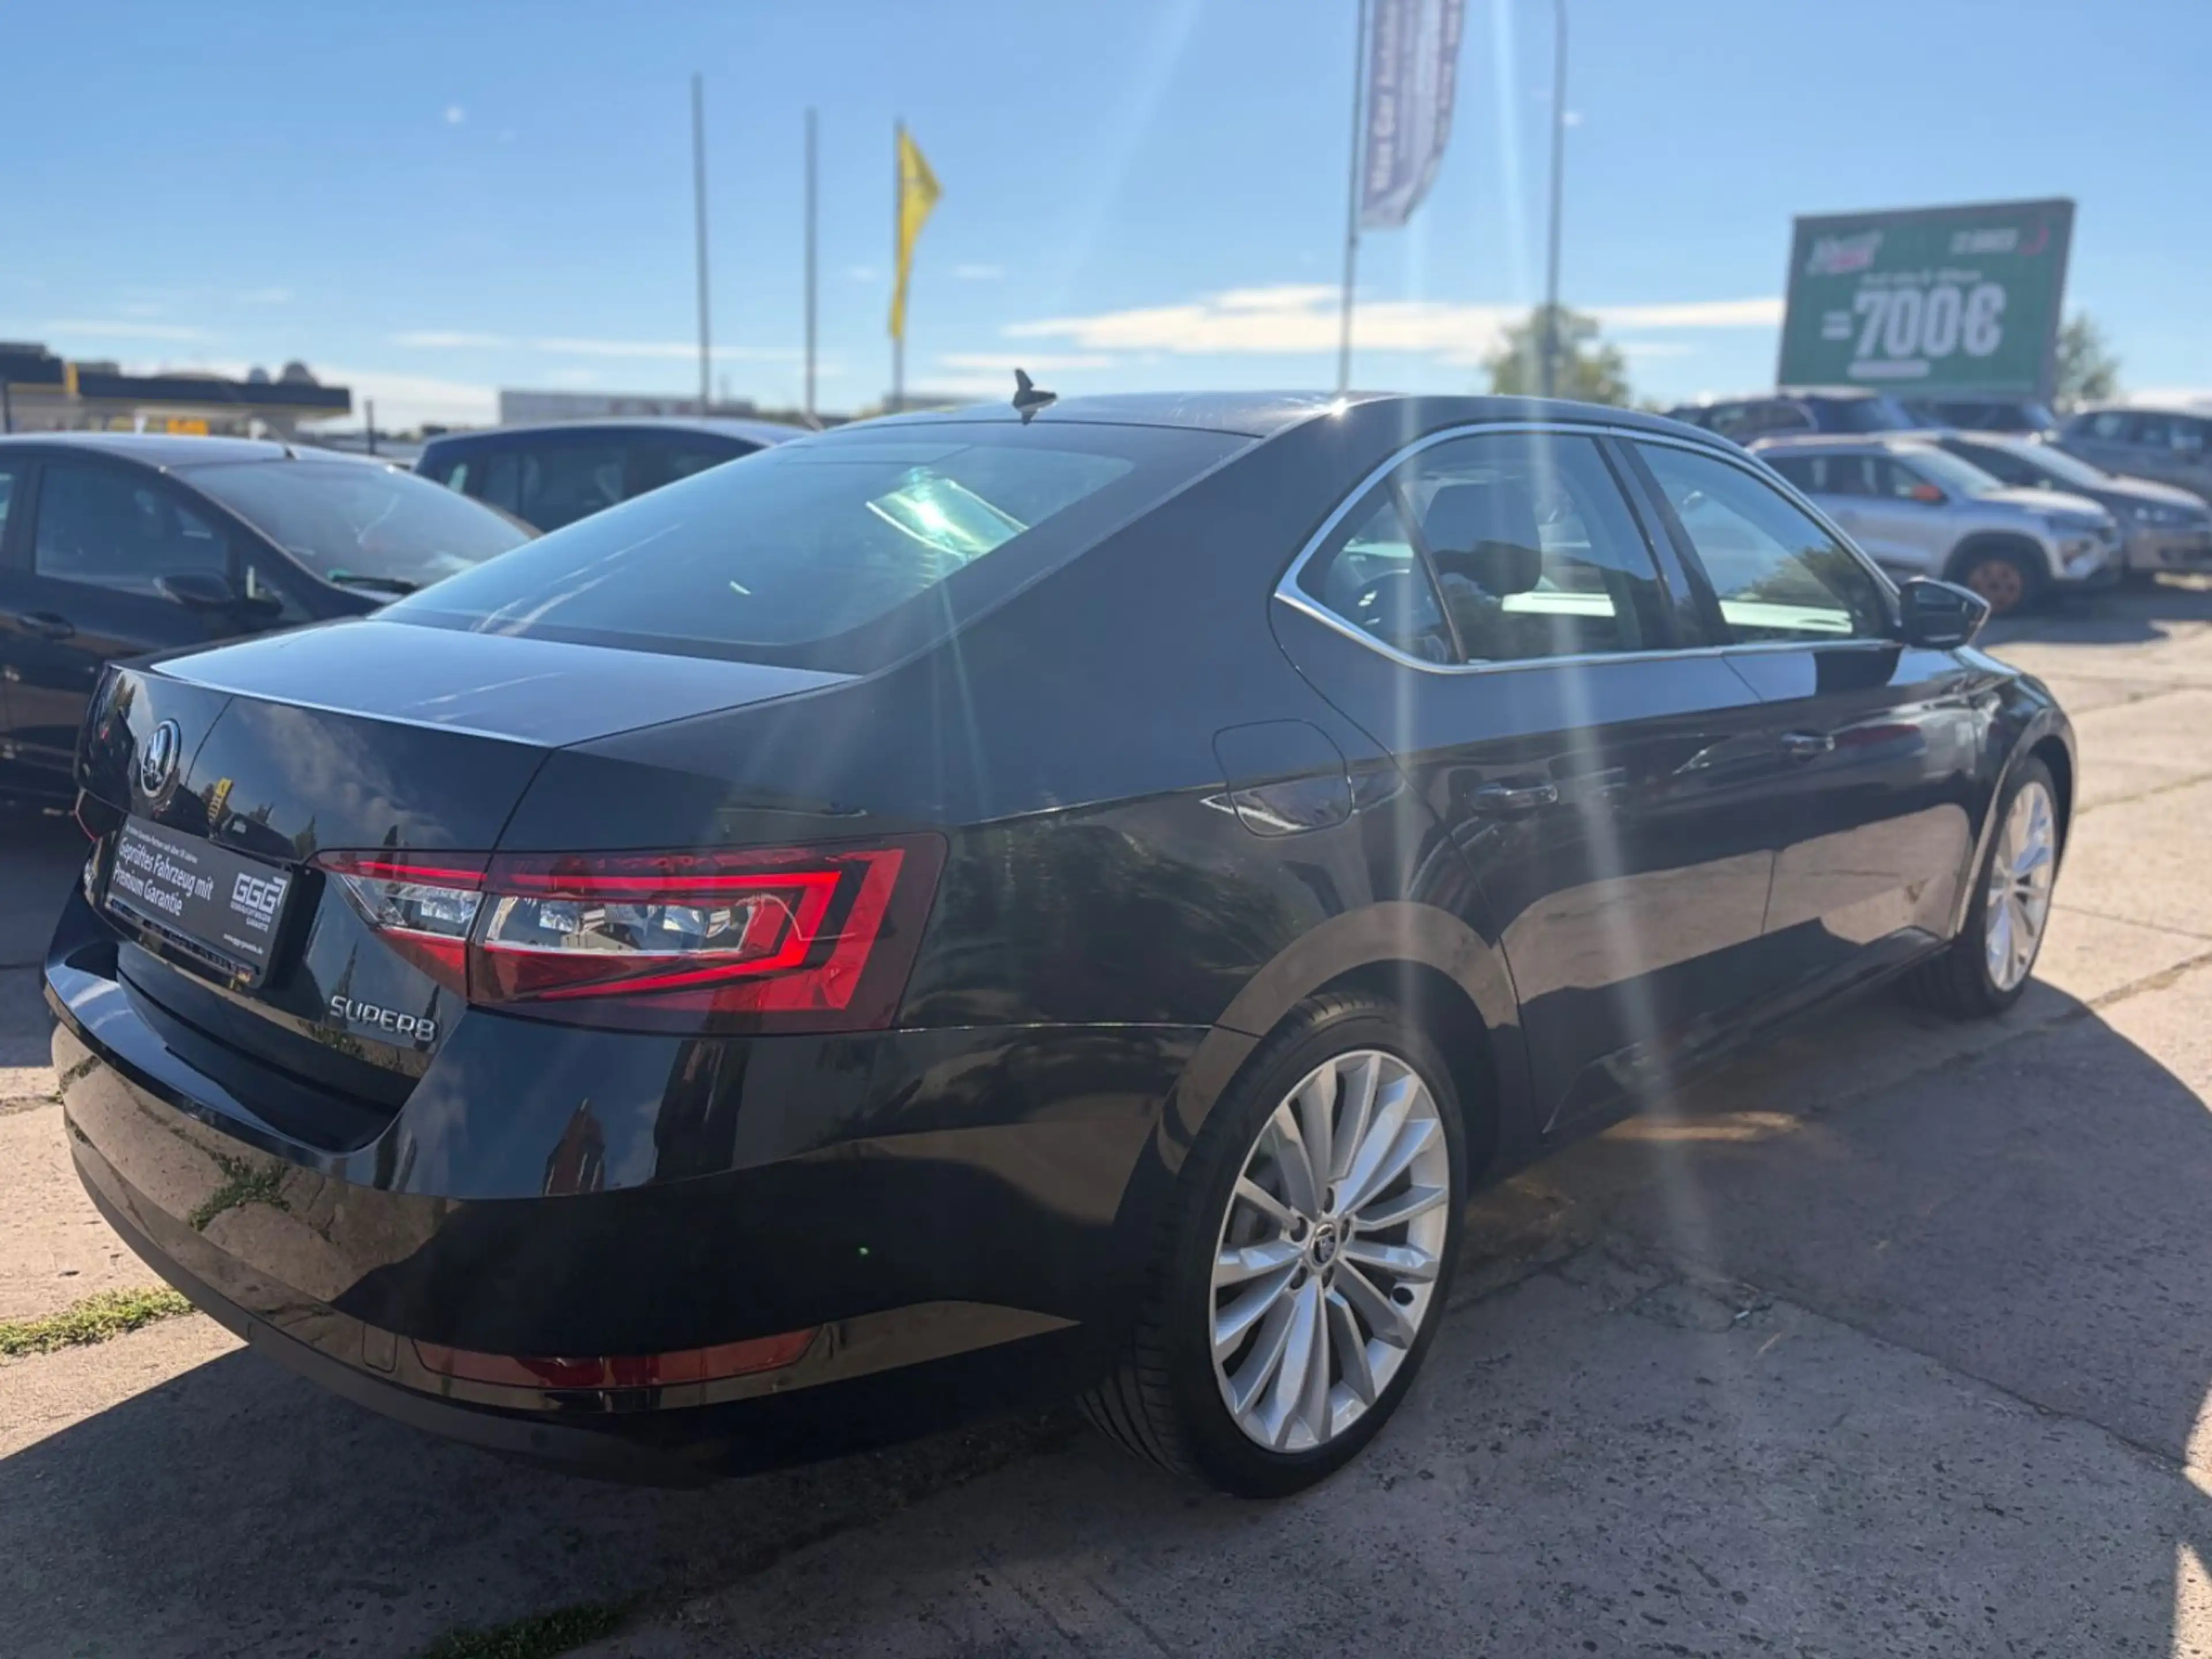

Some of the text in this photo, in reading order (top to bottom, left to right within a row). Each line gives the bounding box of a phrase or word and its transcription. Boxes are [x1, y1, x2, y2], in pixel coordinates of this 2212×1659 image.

[119, 836, 154, 872] Geprüftes
[153, 853, 196, 897] Fahrzeug
[194, 876, 214, 901] mit
[143, 878, 183, 916] Garantie
[232, 872, 283, 915] GGG
[329, 995, 435, 1041] SUPERB
